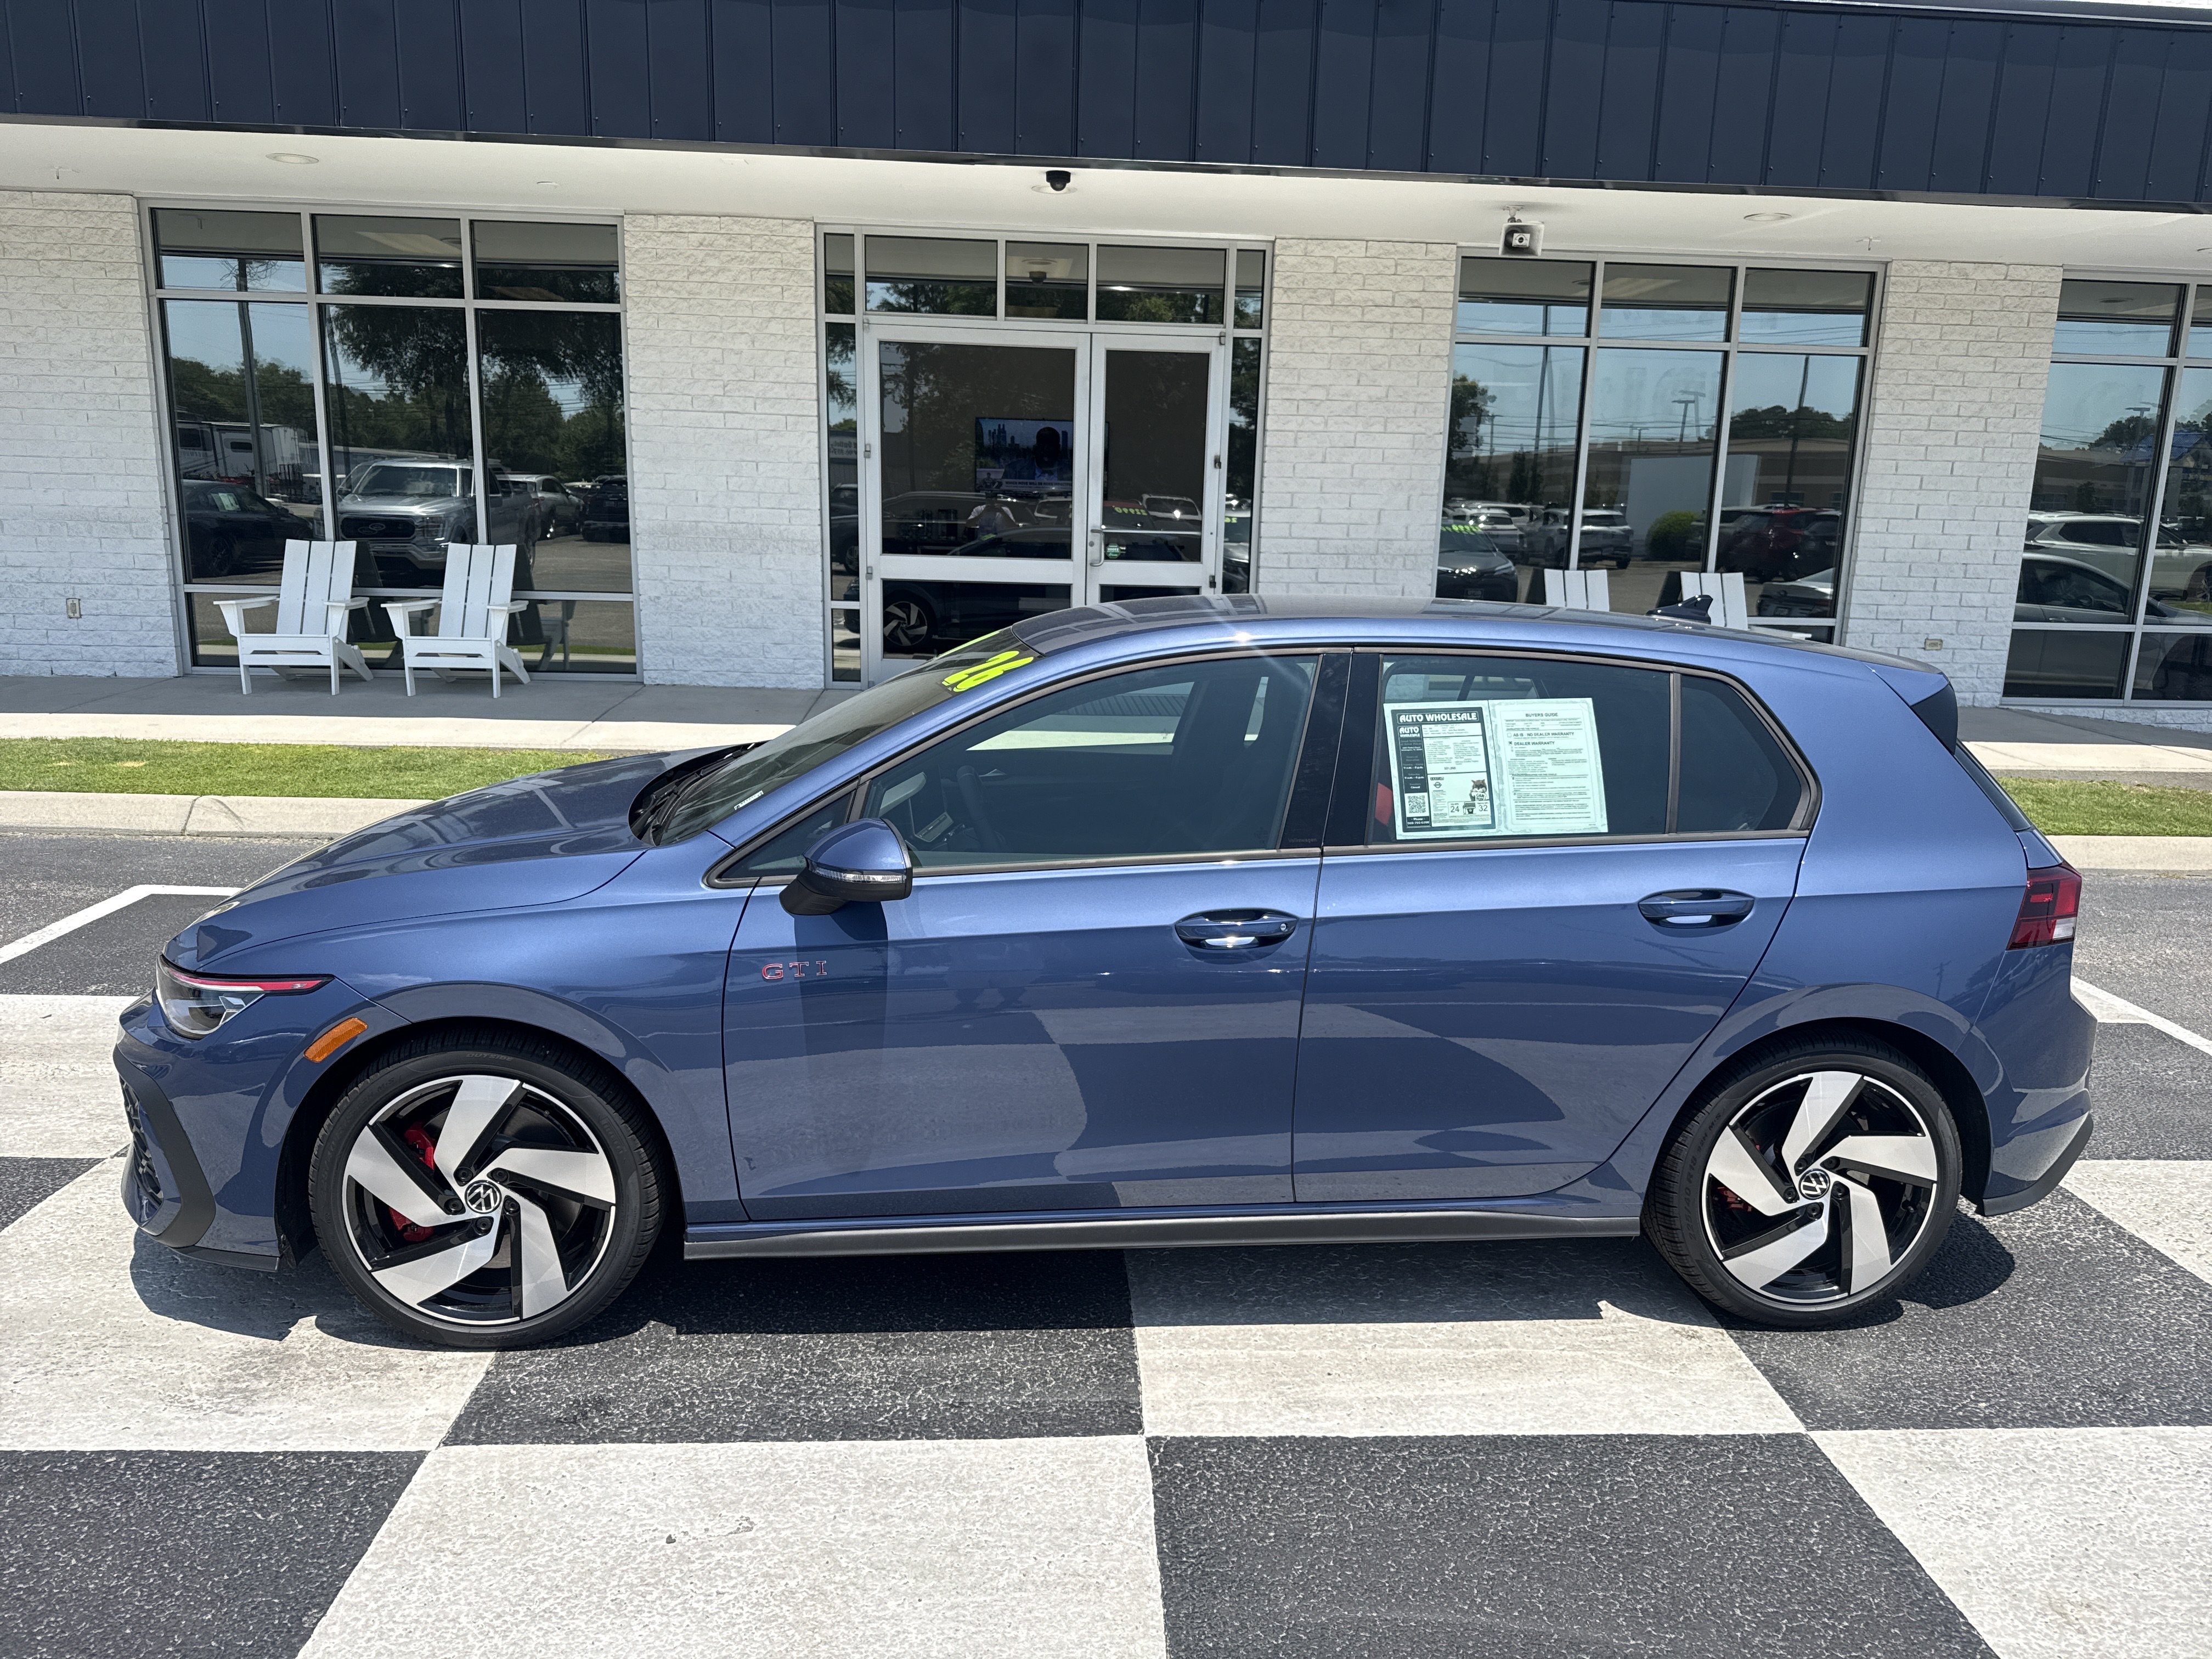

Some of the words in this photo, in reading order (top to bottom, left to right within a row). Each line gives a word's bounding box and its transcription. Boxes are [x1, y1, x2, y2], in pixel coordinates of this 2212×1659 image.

[1400, 714, 1423, 723] AUTO
[1425, 713, 1477, 721] WHOLESALE
[761, 960, 827, 980] GTI
[466, 1053, 514, 1062] OUTSIDE
[1686, 1155, 1697, 1183] R18
[1684, 1187, 1697, 1241] 225/40
